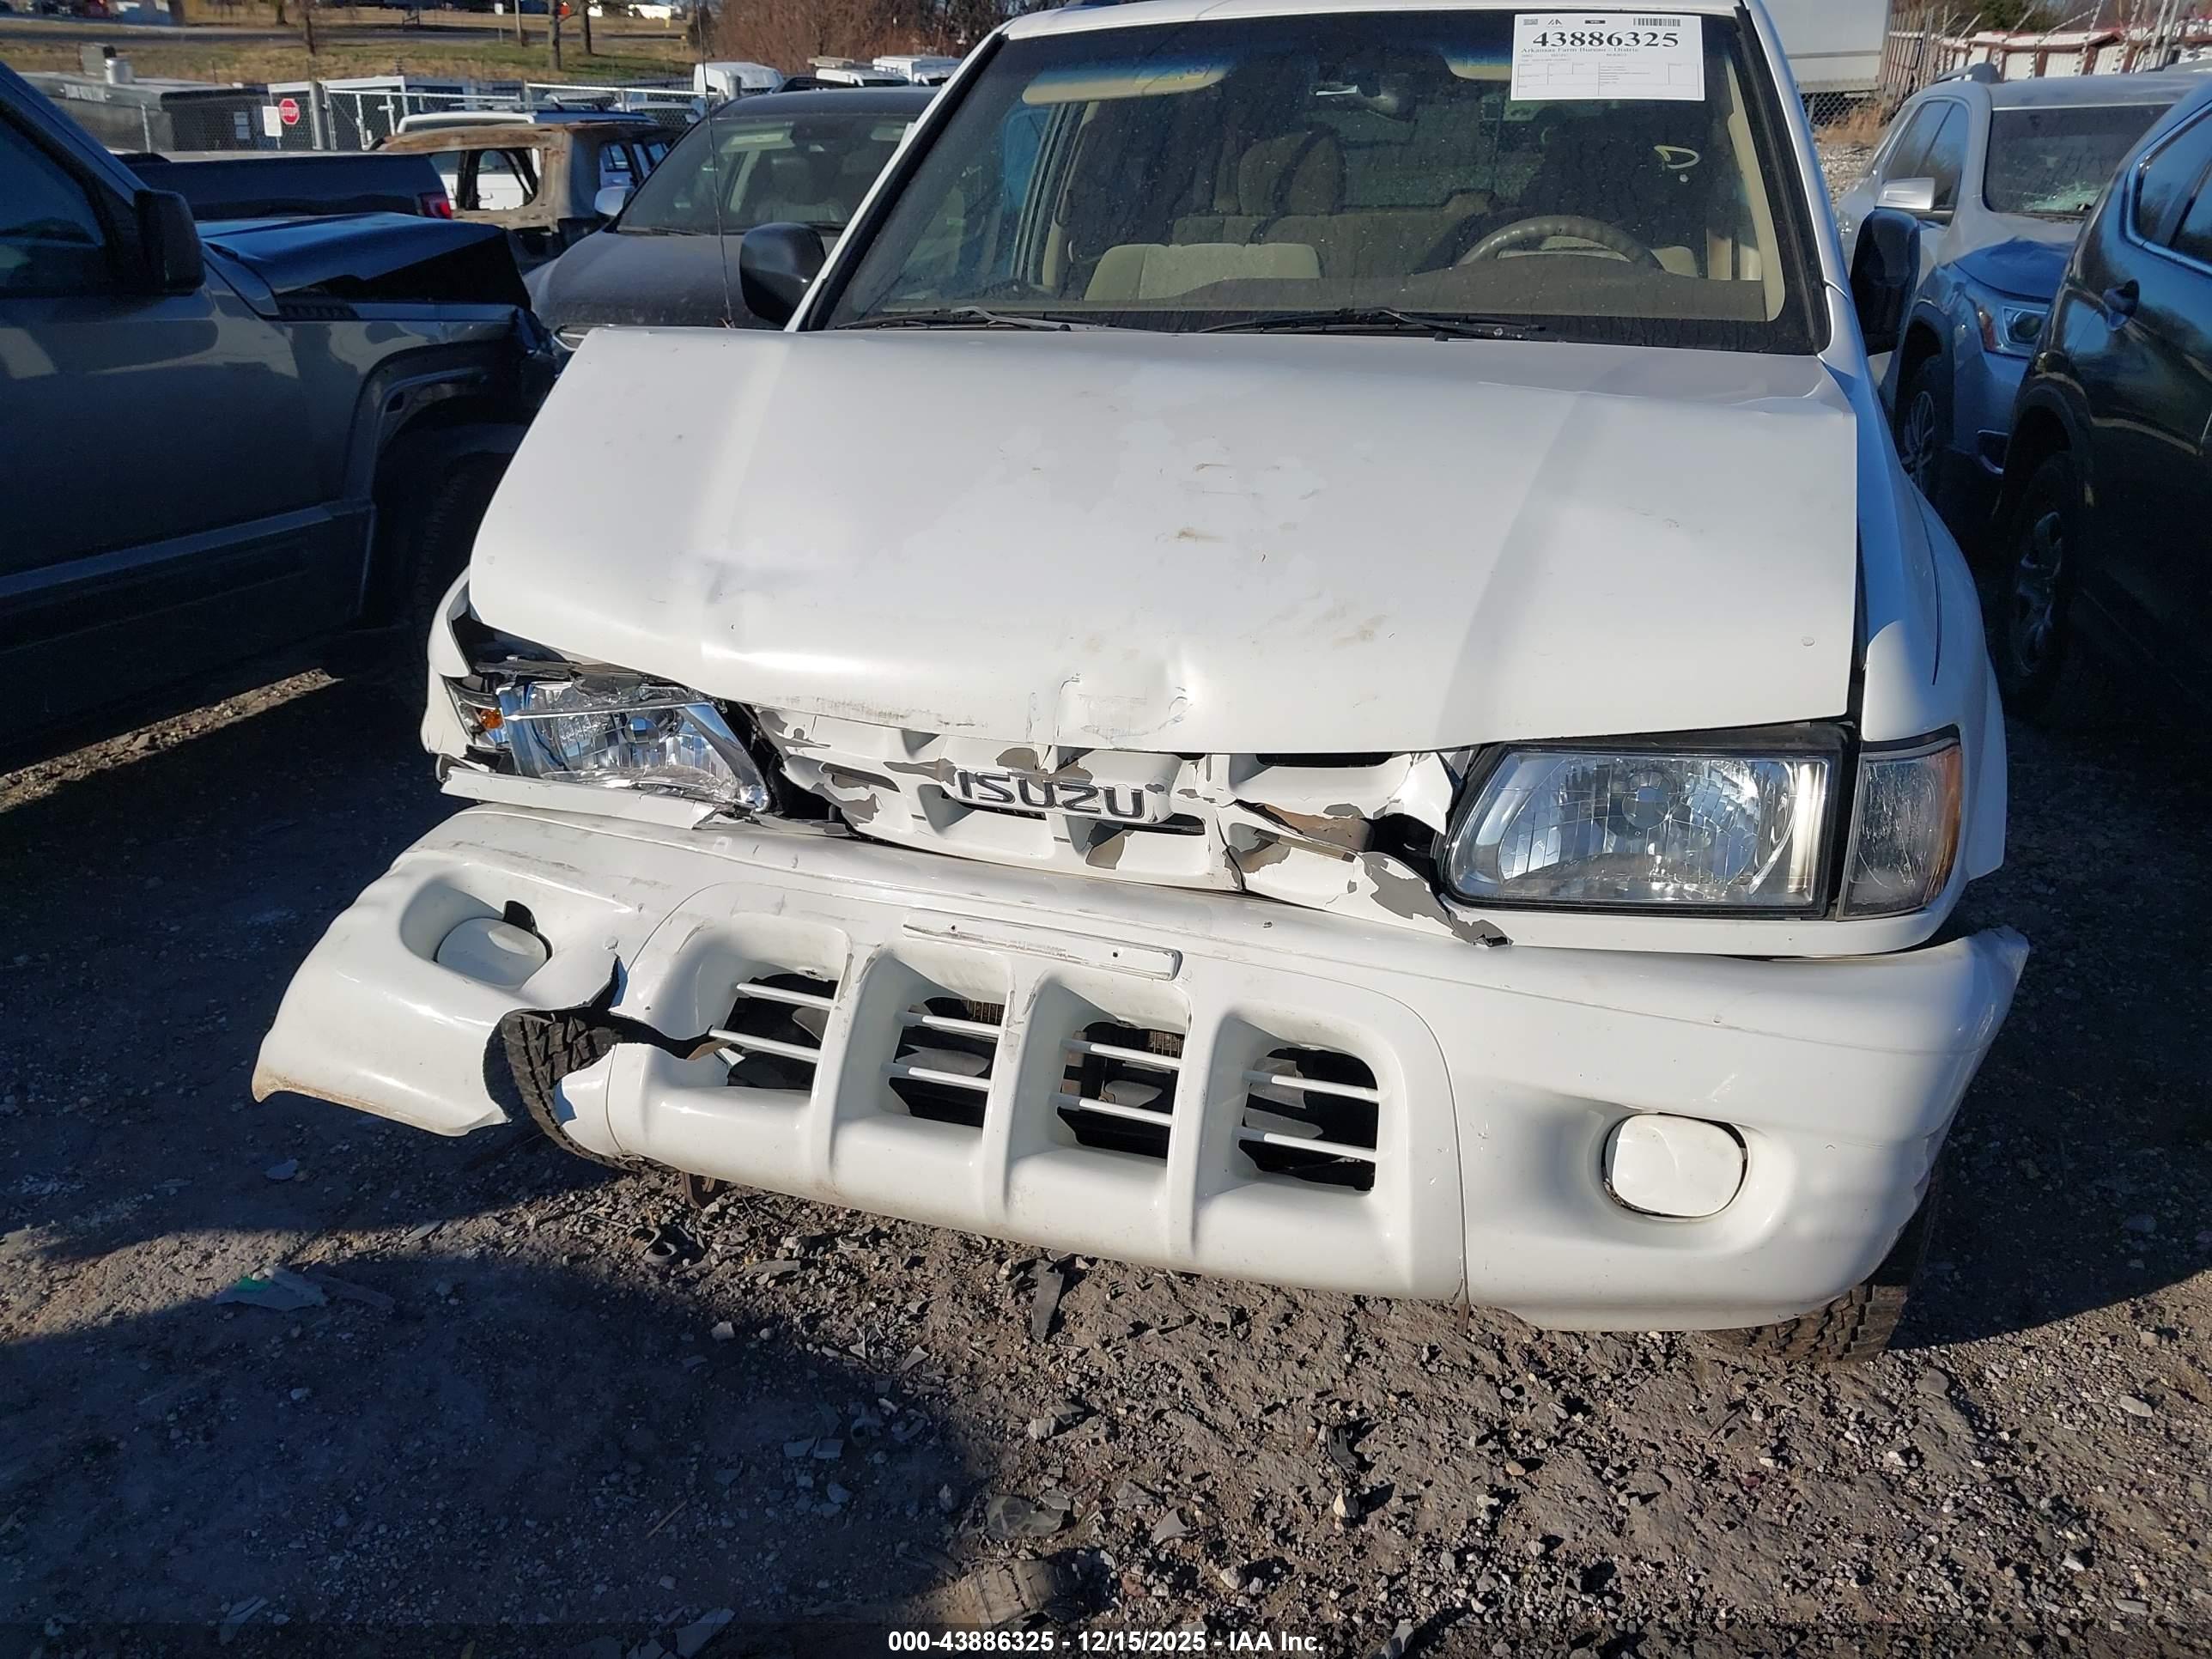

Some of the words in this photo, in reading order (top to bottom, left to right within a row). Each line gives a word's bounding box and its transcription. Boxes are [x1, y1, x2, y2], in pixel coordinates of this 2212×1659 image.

[1533, 31, 1680, 47] 43886325
[281, 106, 298, 117] STOP
[955, 769, 1146, 820] ISUZU
